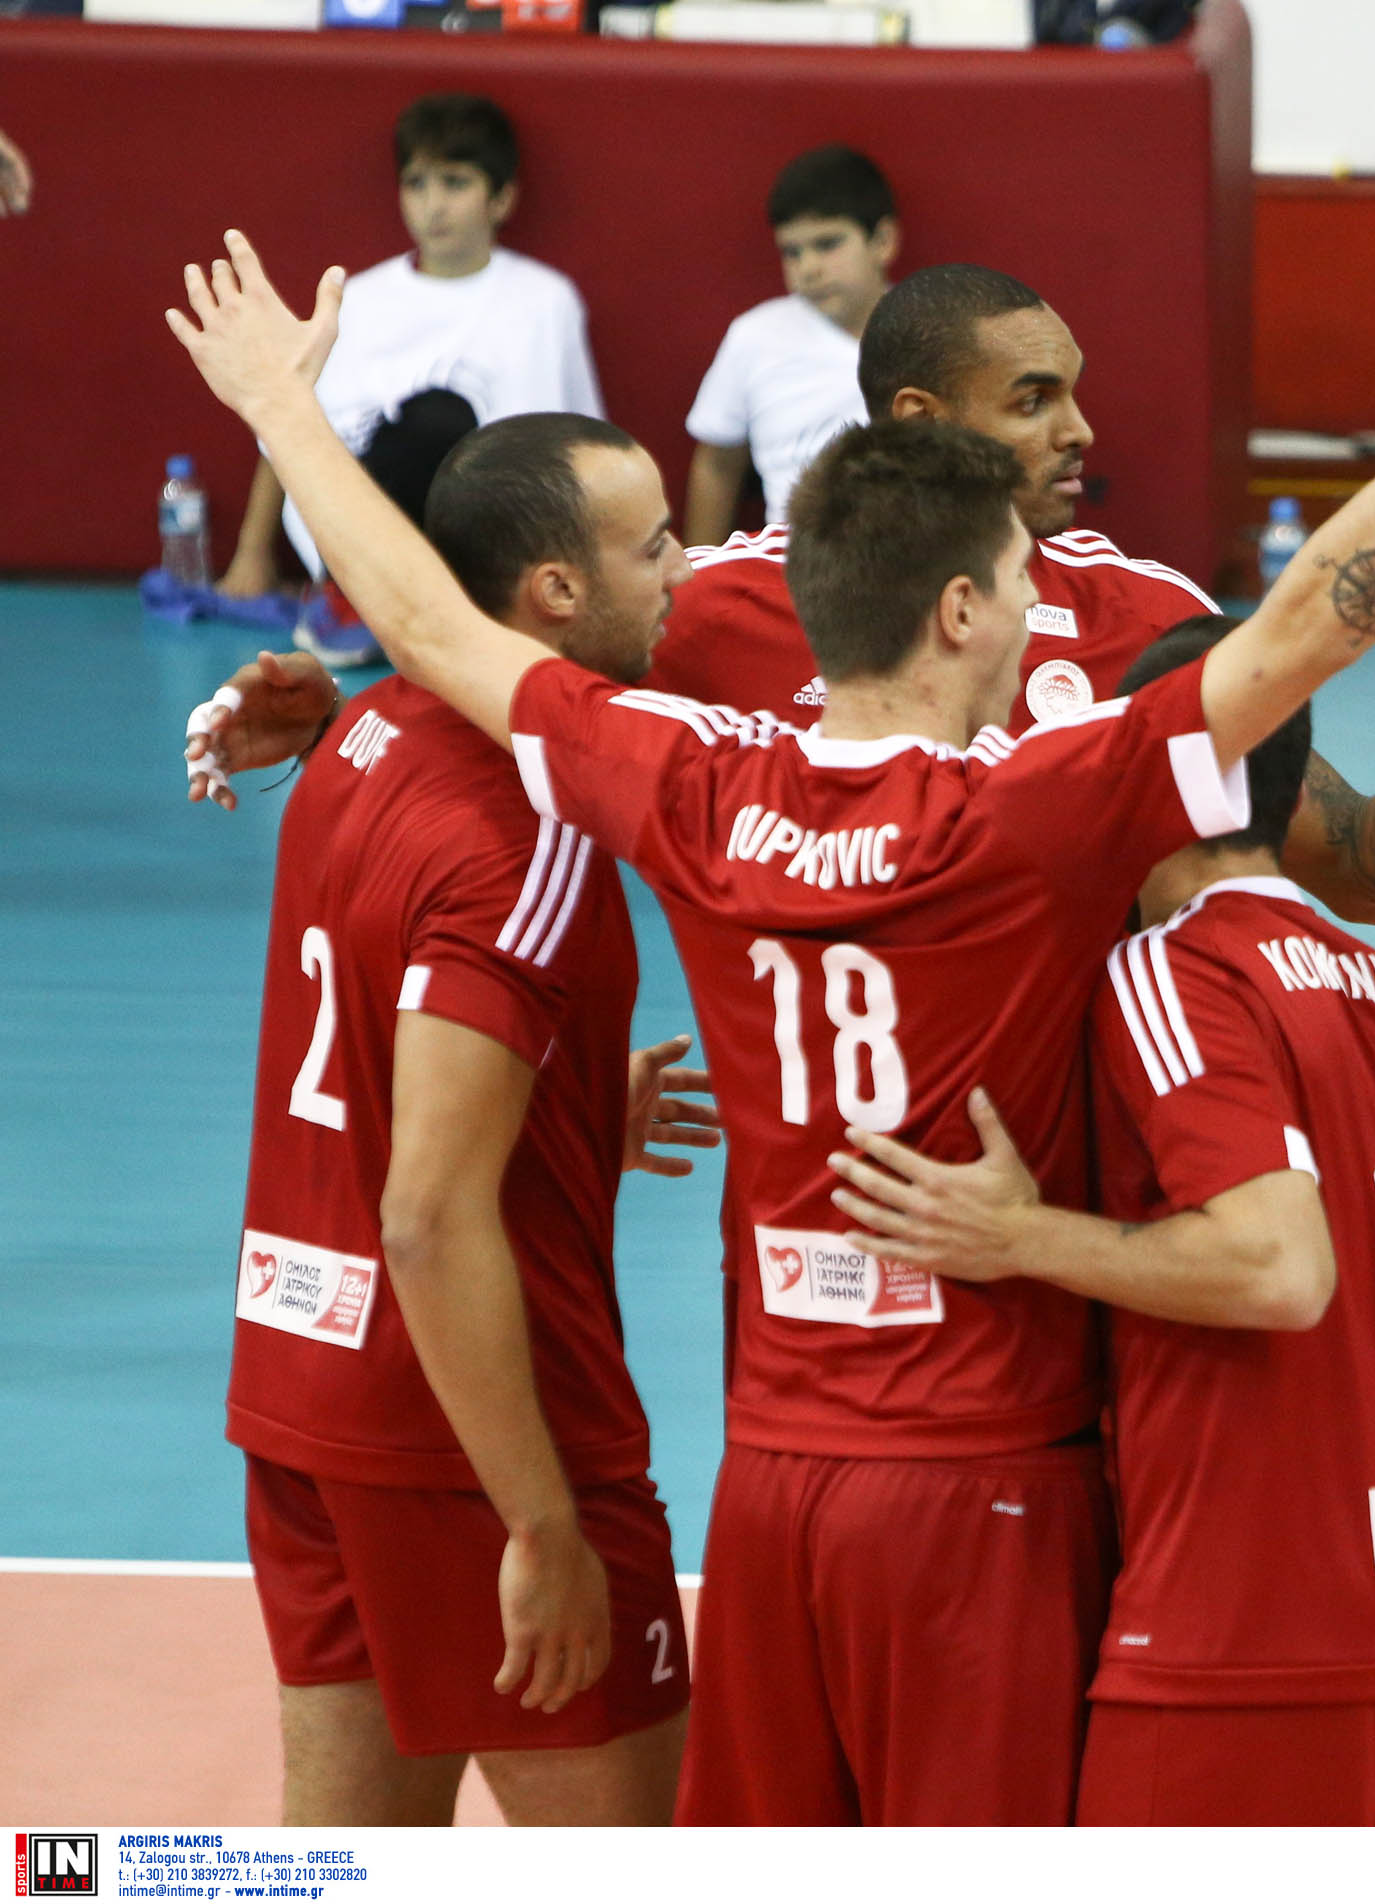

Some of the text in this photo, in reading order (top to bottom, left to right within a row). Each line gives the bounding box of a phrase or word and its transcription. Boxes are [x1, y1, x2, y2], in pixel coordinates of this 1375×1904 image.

[288, 926, 346, 1132] 2
[748, 938, 910, 1133] 18
[644, 1618, 678, 1686] 2
